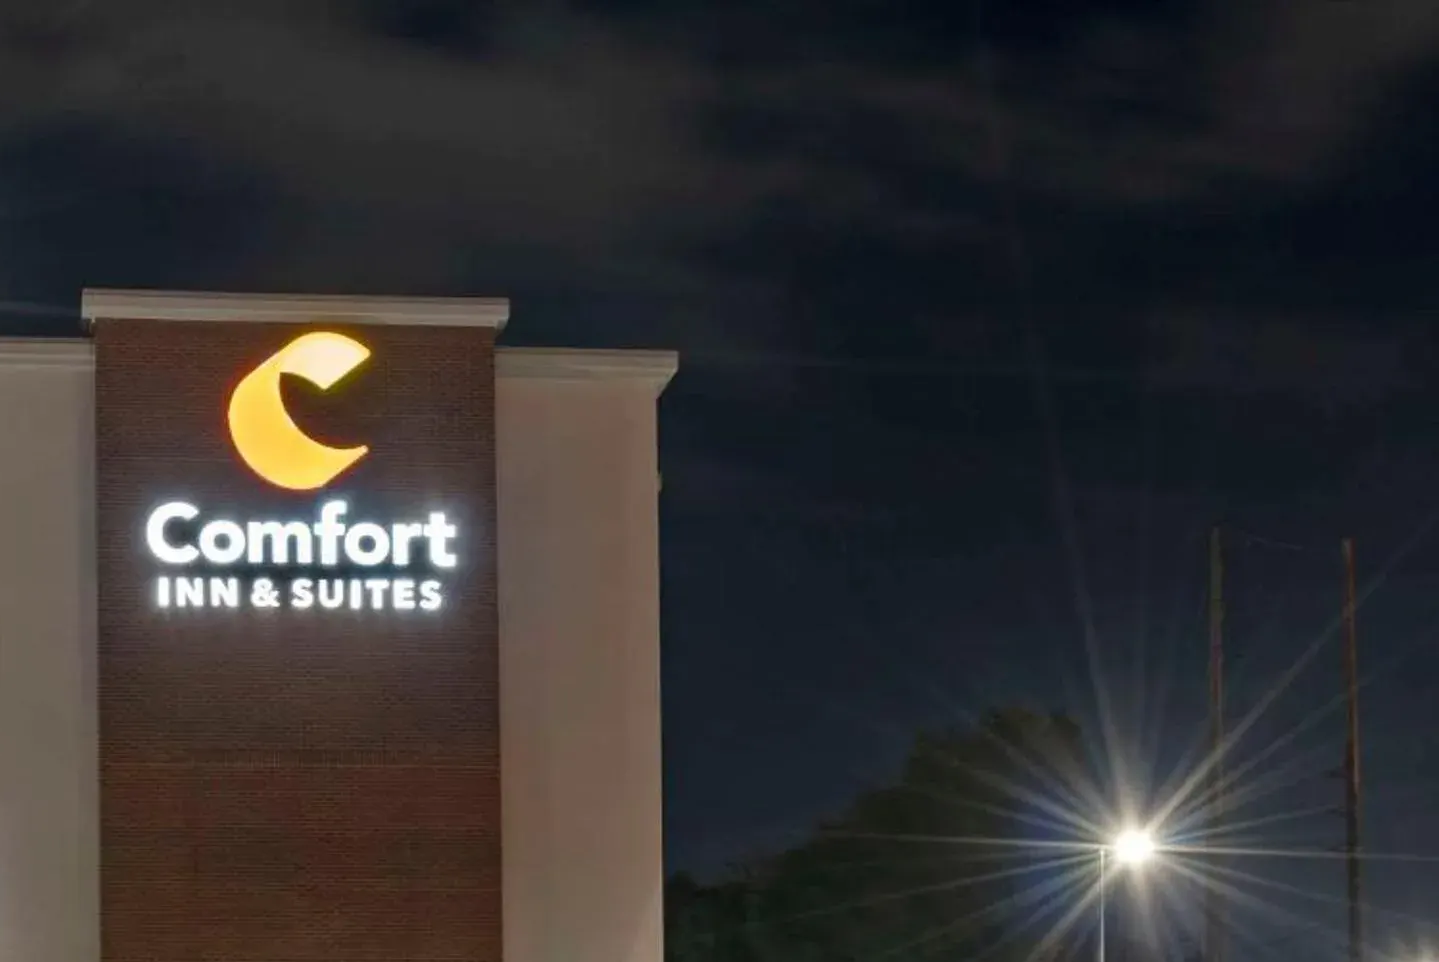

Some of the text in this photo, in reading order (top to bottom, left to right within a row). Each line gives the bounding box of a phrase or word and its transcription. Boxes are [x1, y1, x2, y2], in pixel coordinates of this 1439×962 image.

[145, 500, 458, 567] Comfort
[157, 576, 443, 611] INN & SUITES
